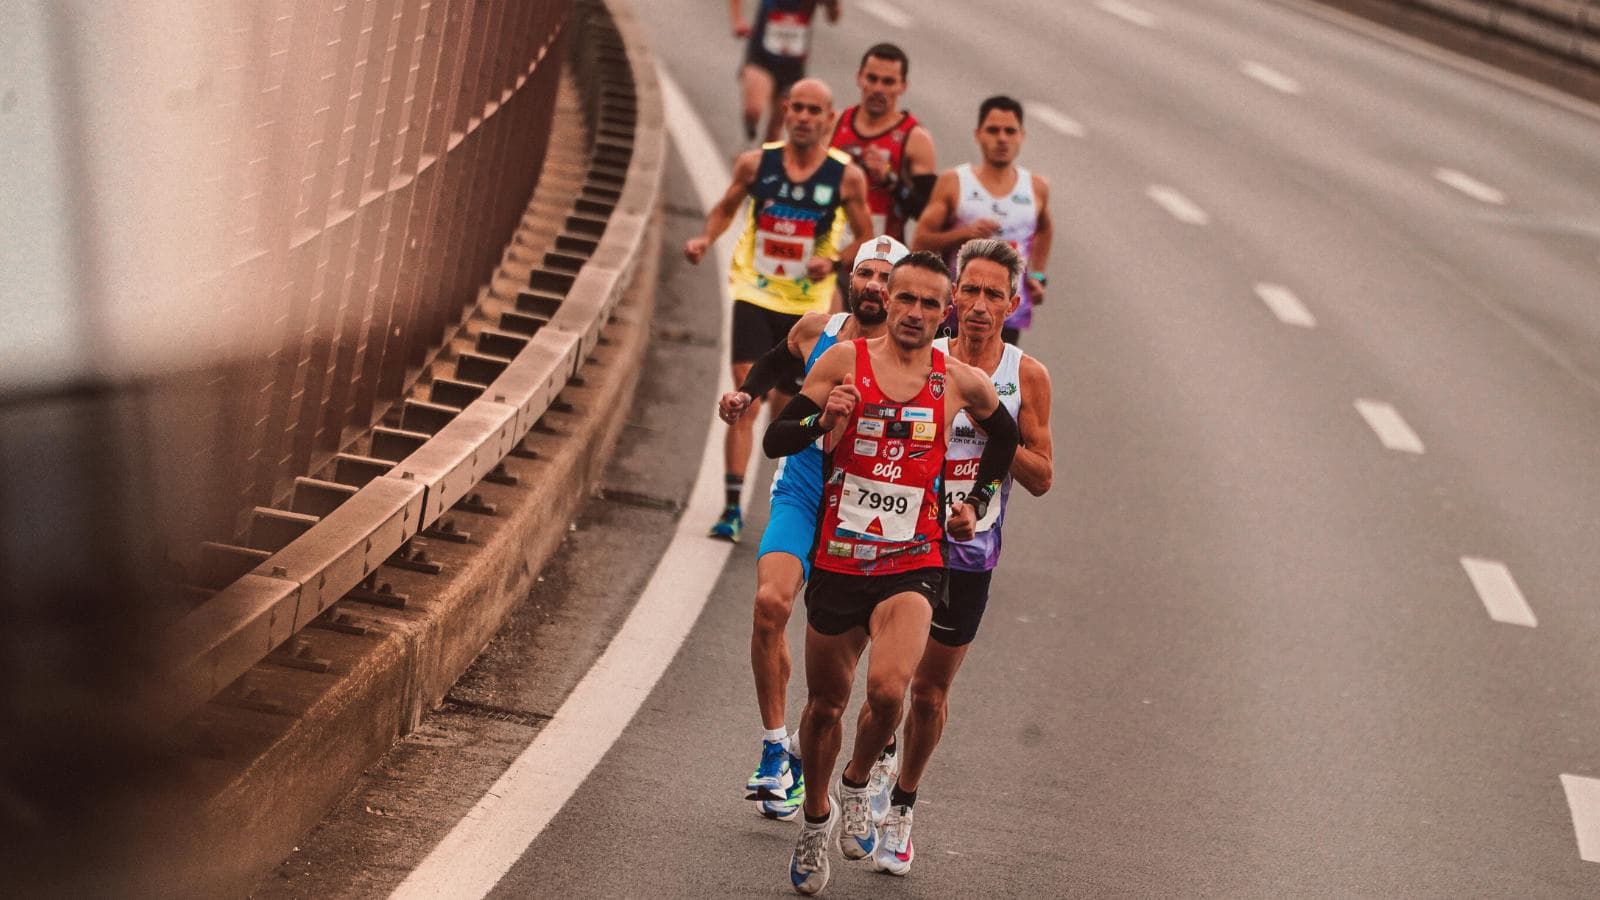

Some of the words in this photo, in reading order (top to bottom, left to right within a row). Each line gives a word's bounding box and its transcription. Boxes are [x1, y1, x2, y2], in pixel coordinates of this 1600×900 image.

[872, 461, 902, 483] edp
[857, 488, 908, 514] 7999
[945, 491, 966, 508] 43
